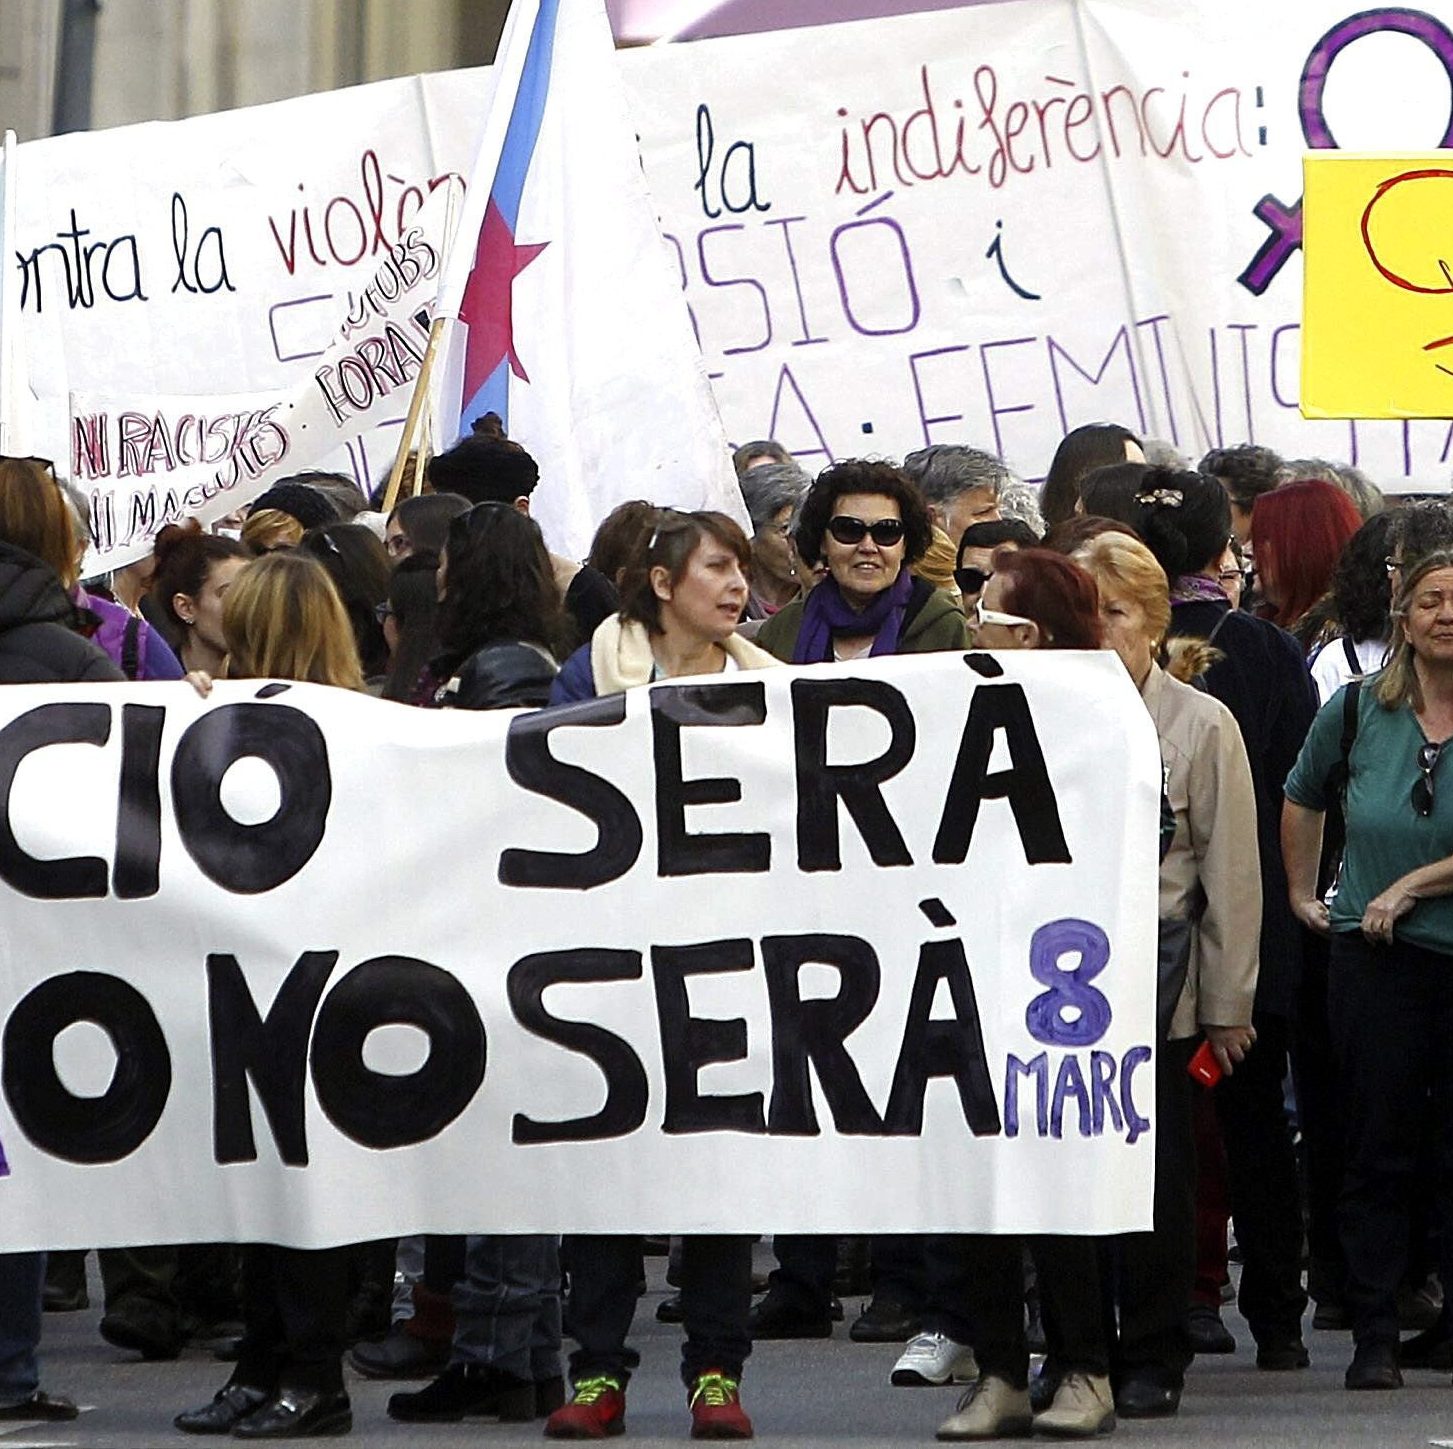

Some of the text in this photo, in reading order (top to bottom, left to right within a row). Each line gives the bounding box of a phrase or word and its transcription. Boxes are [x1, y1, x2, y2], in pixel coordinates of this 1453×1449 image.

[693, 62, 1271, 219] la indiferència:
[171, 191, 237, 295] la
[497, 652, 1073, 892] SERÀ
[2, 968, 173, 1164] O
[205, 947, 488, 1167] NO
[508, 897, 1003, 1146] SERÀ
[1024, 916, 1113, 1049] 8
[1003, 1044, 1153, 1144] MARÇ
